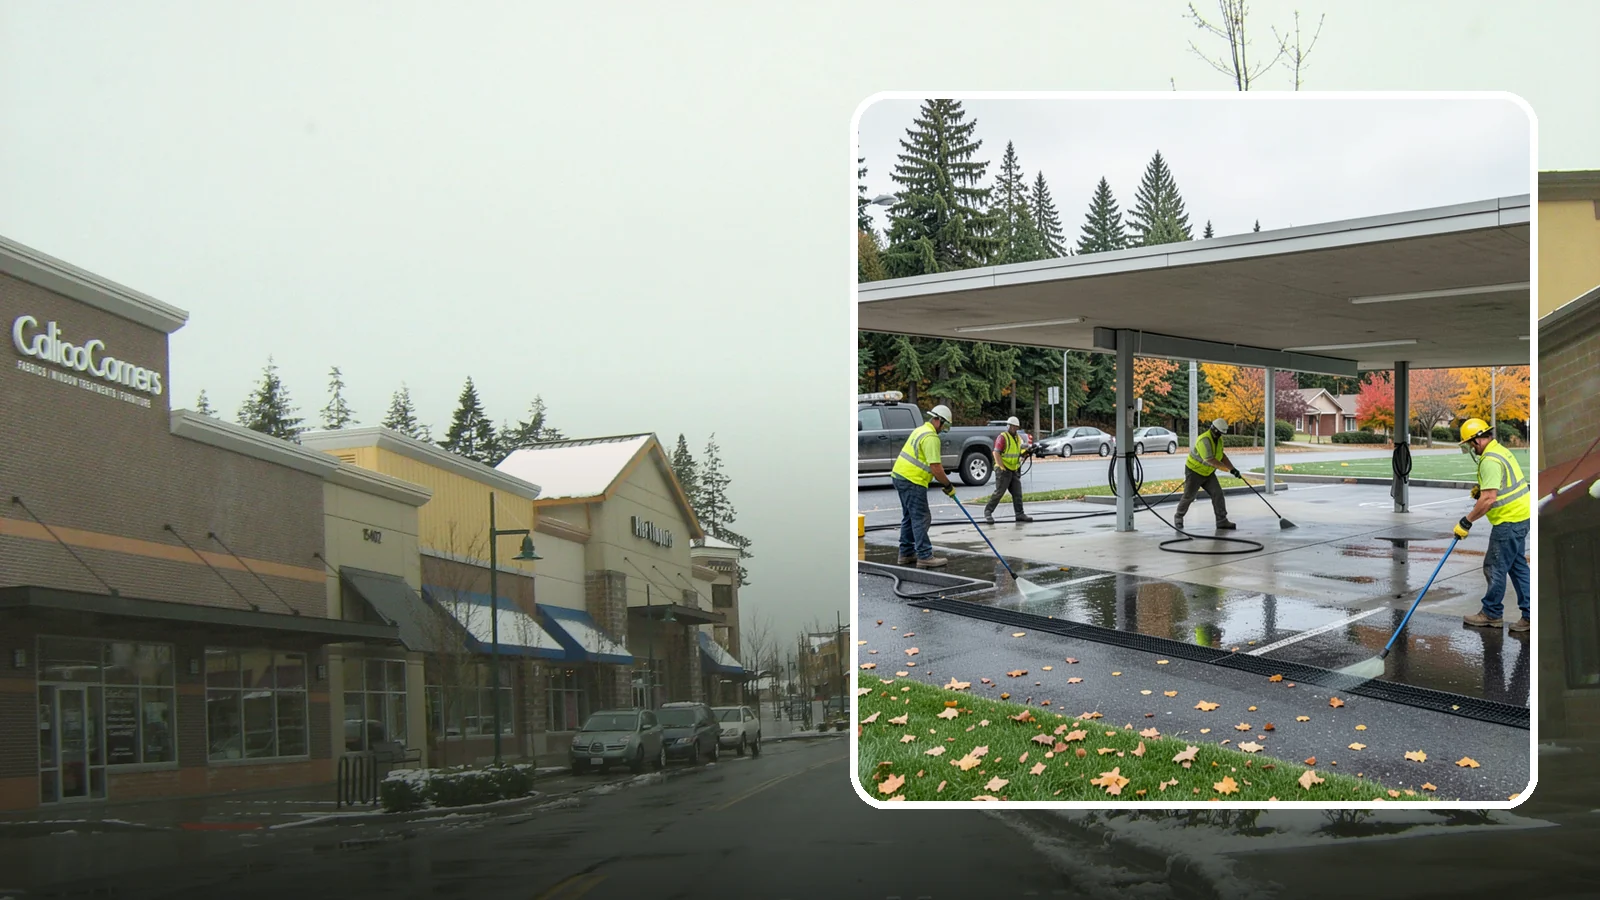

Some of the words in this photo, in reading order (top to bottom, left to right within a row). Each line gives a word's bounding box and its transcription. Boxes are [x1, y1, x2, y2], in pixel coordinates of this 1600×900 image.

[12, 315, 162, 395] CalicoCorners
[16, 360, 47, 378] FABRICS
[51, 370, 78, 387] WINDOW
[79, 379, 116, 398] TREATMENTS
[121, 391, 151, 408] FURNITURE
